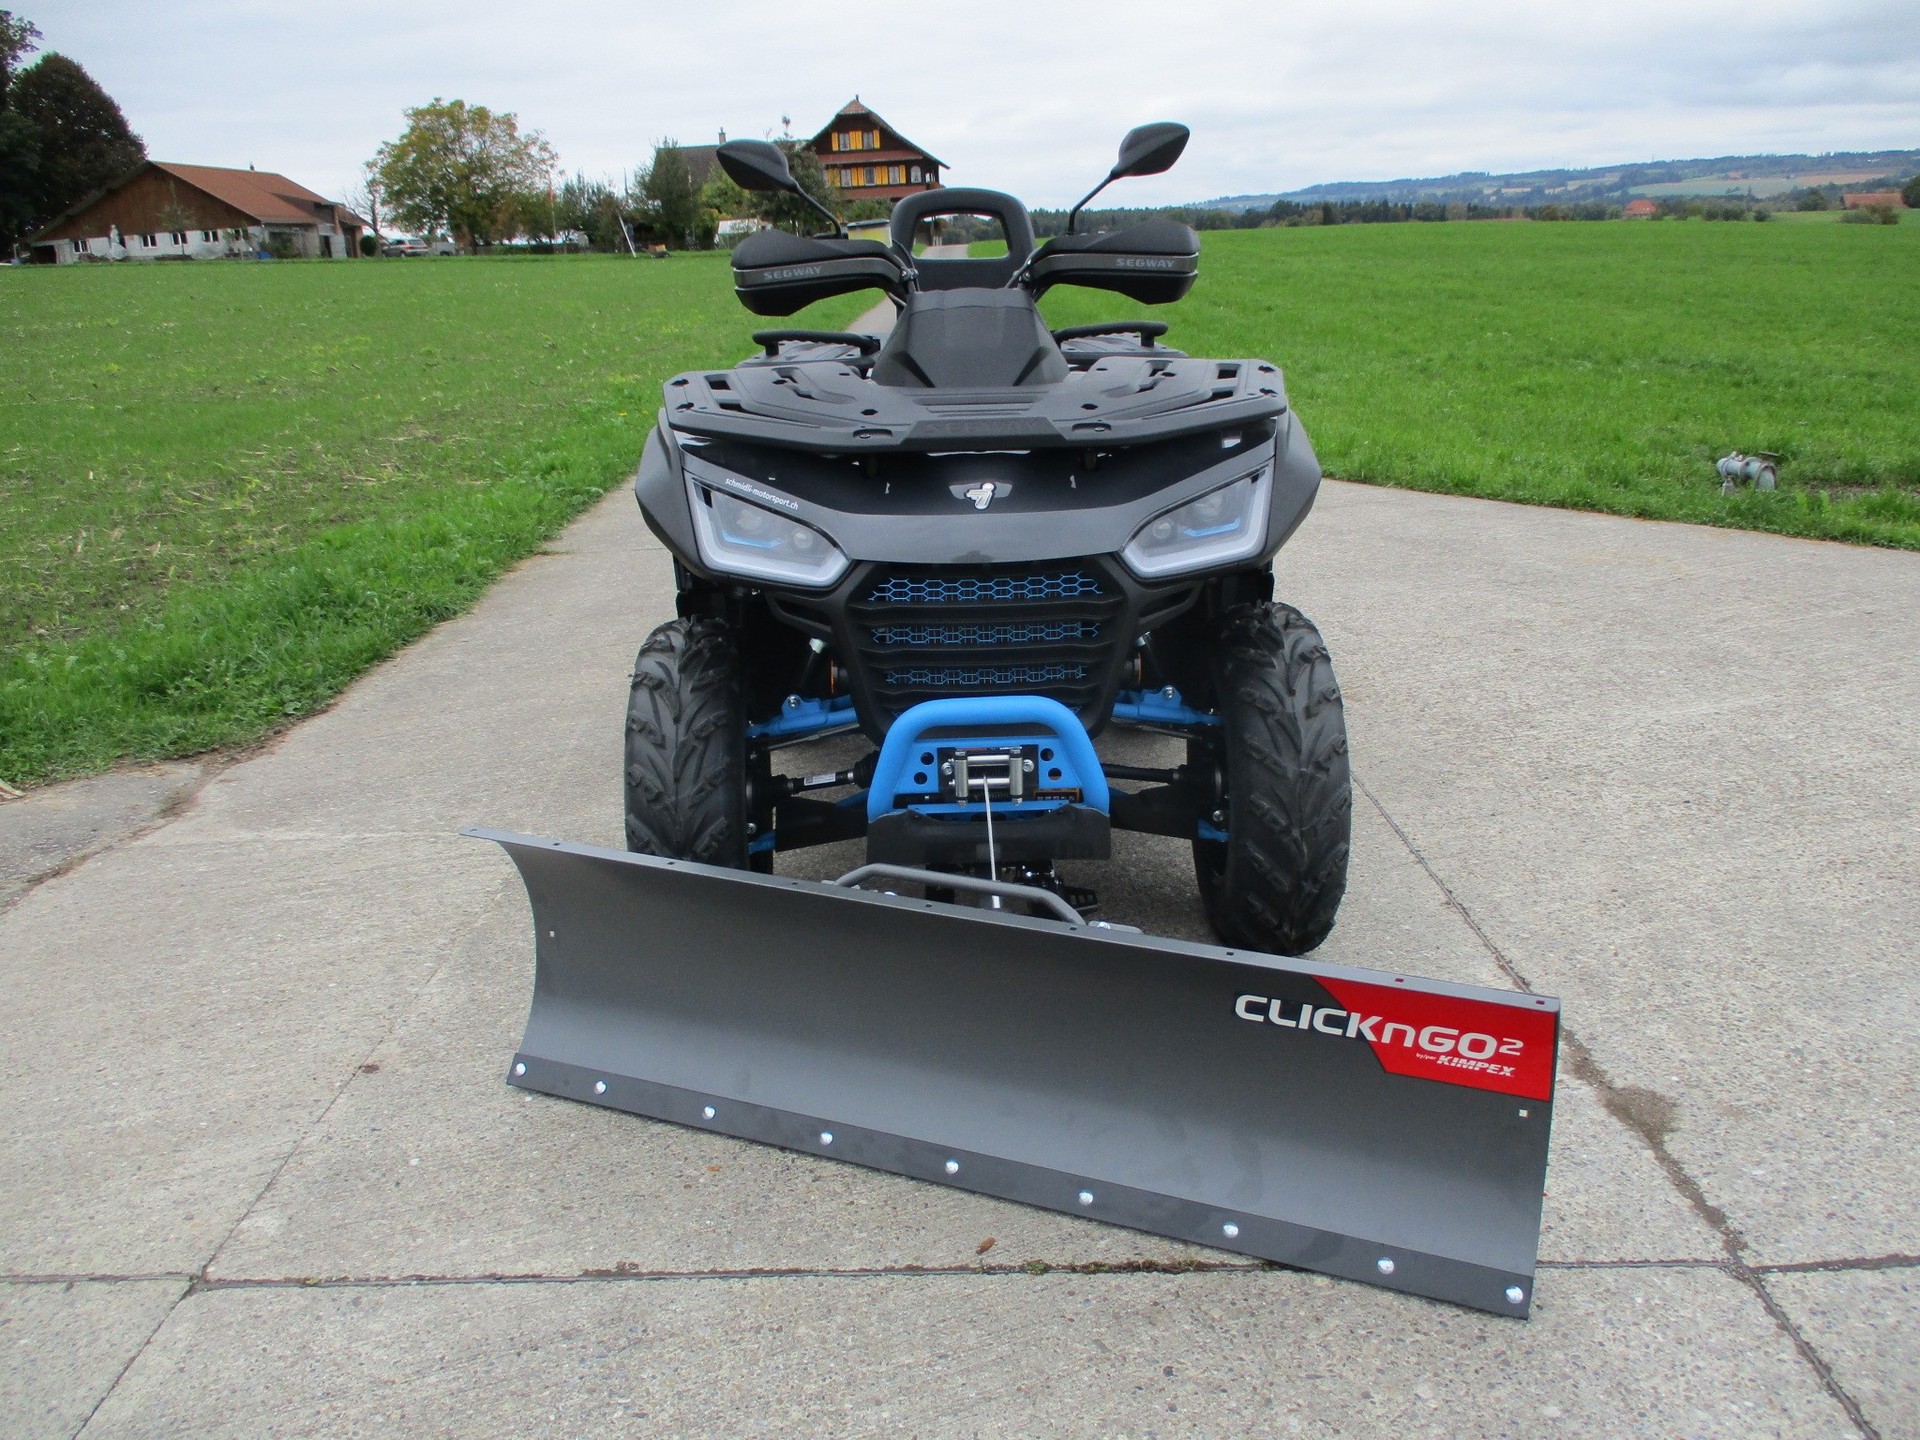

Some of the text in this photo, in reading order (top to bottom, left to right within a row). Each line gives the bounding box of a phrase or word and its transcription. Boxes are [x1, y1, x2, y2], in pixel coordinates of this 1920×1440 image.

[1116, 258, 1175, 268] SEGWAY
[763, 266, 822, 281] SEGWAY
[725, 477, 799, 510] schmidli-motorsport.ch
[1436, 1055, 1516, 1077] KIMPEX
